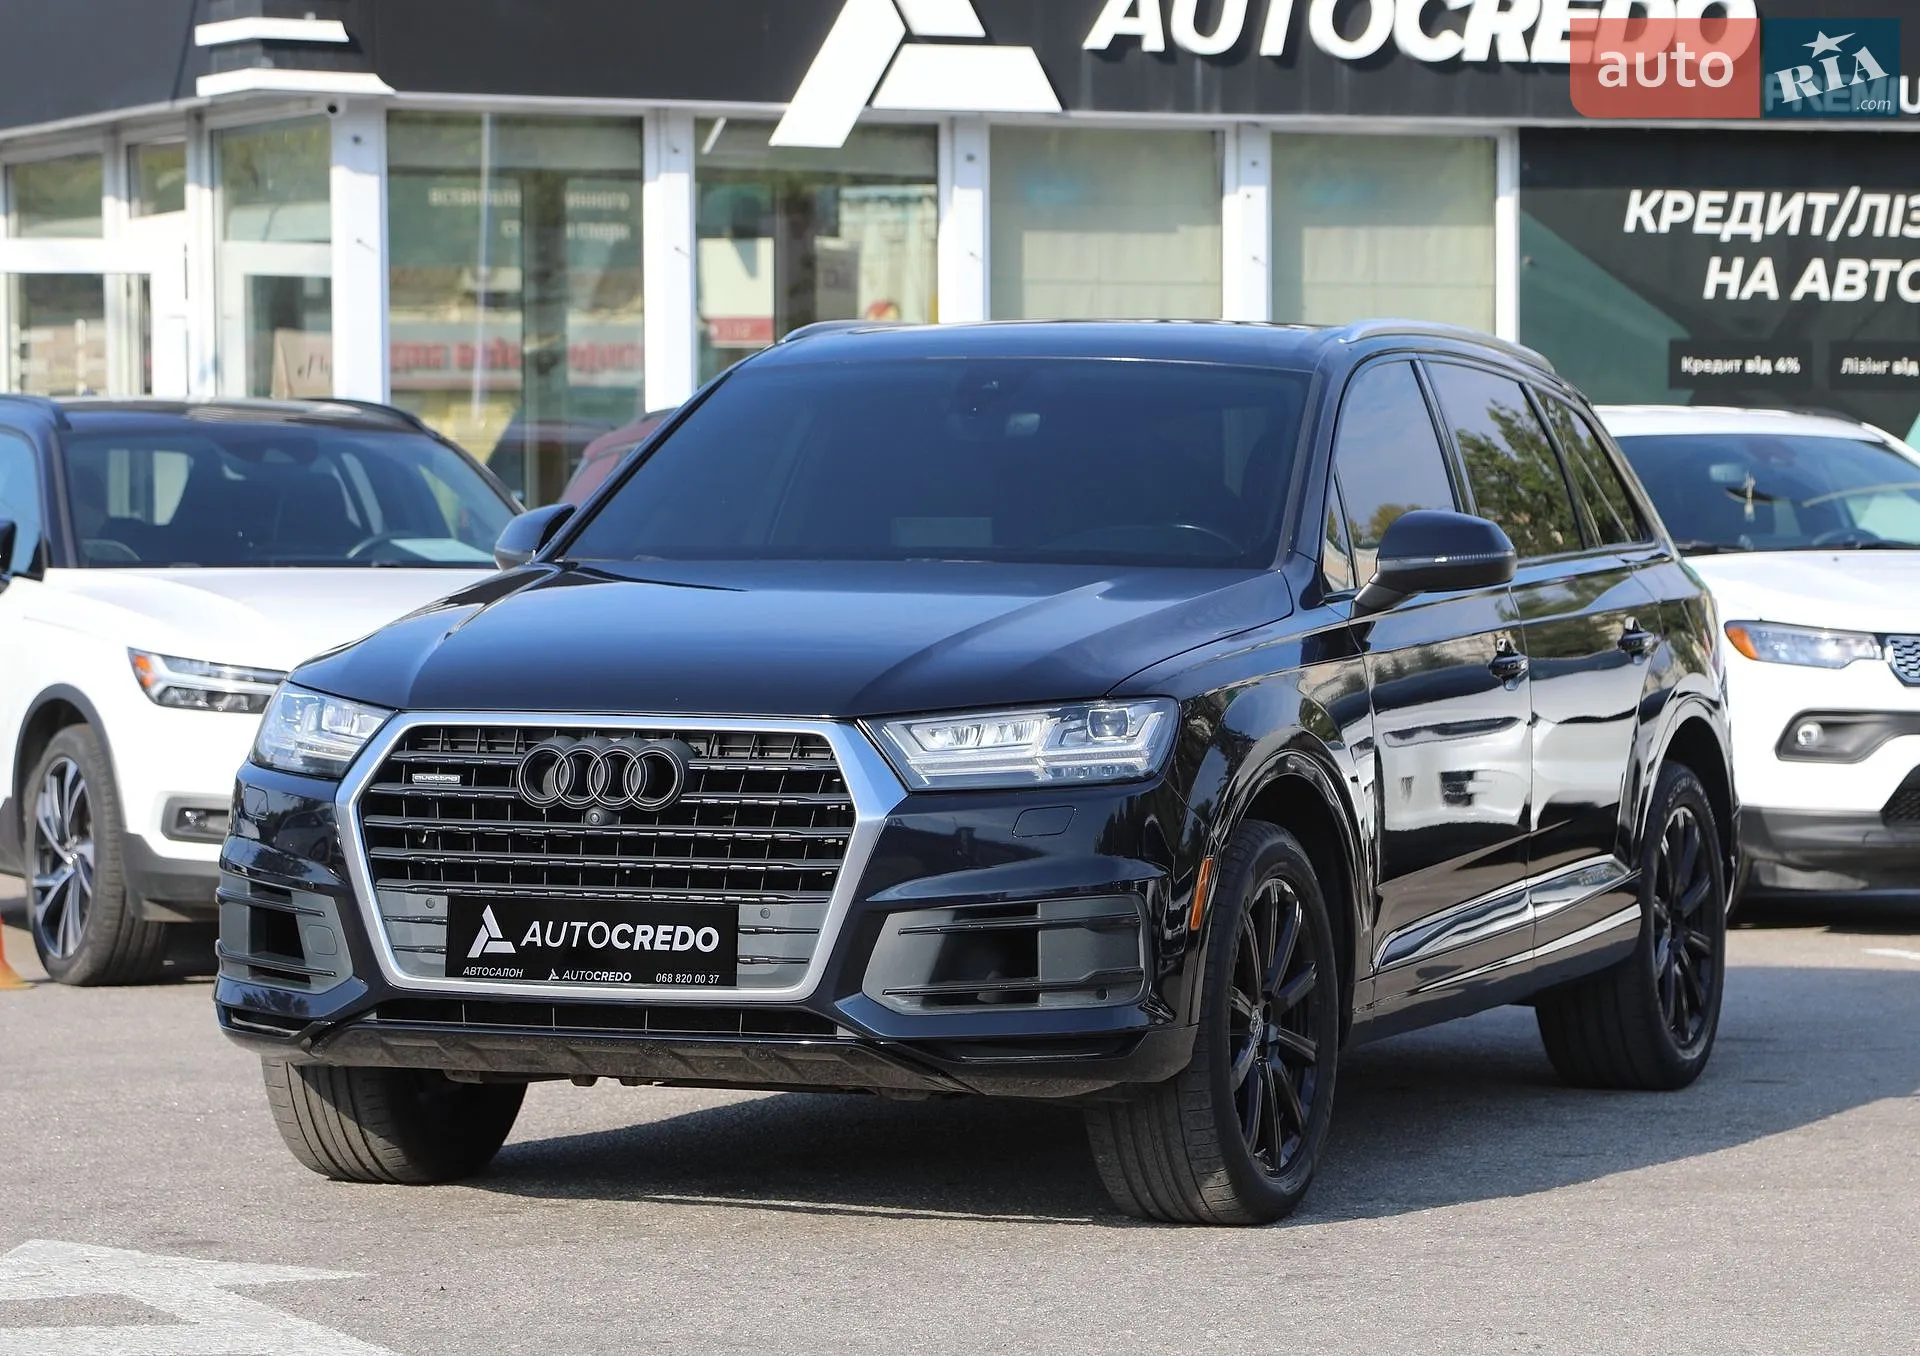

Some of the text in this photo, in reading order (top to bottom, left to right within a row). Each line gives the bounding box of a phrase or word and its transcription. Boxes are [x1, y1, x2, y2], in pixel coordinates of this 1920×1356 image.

[1703, 256, 1780, 300] НА
[1681, 355, 1801, 376] Кредит від 4%
[1840, 357, 1890, 376] Лізінг
[520, 920, 720, 953] AUTOCREDO
[462, 966, 524, 978] АВТОСАЛОН
[562, 969, 632, 982] AUTOCREDO
[655, 972, 720, 984] 068 820 00 37
